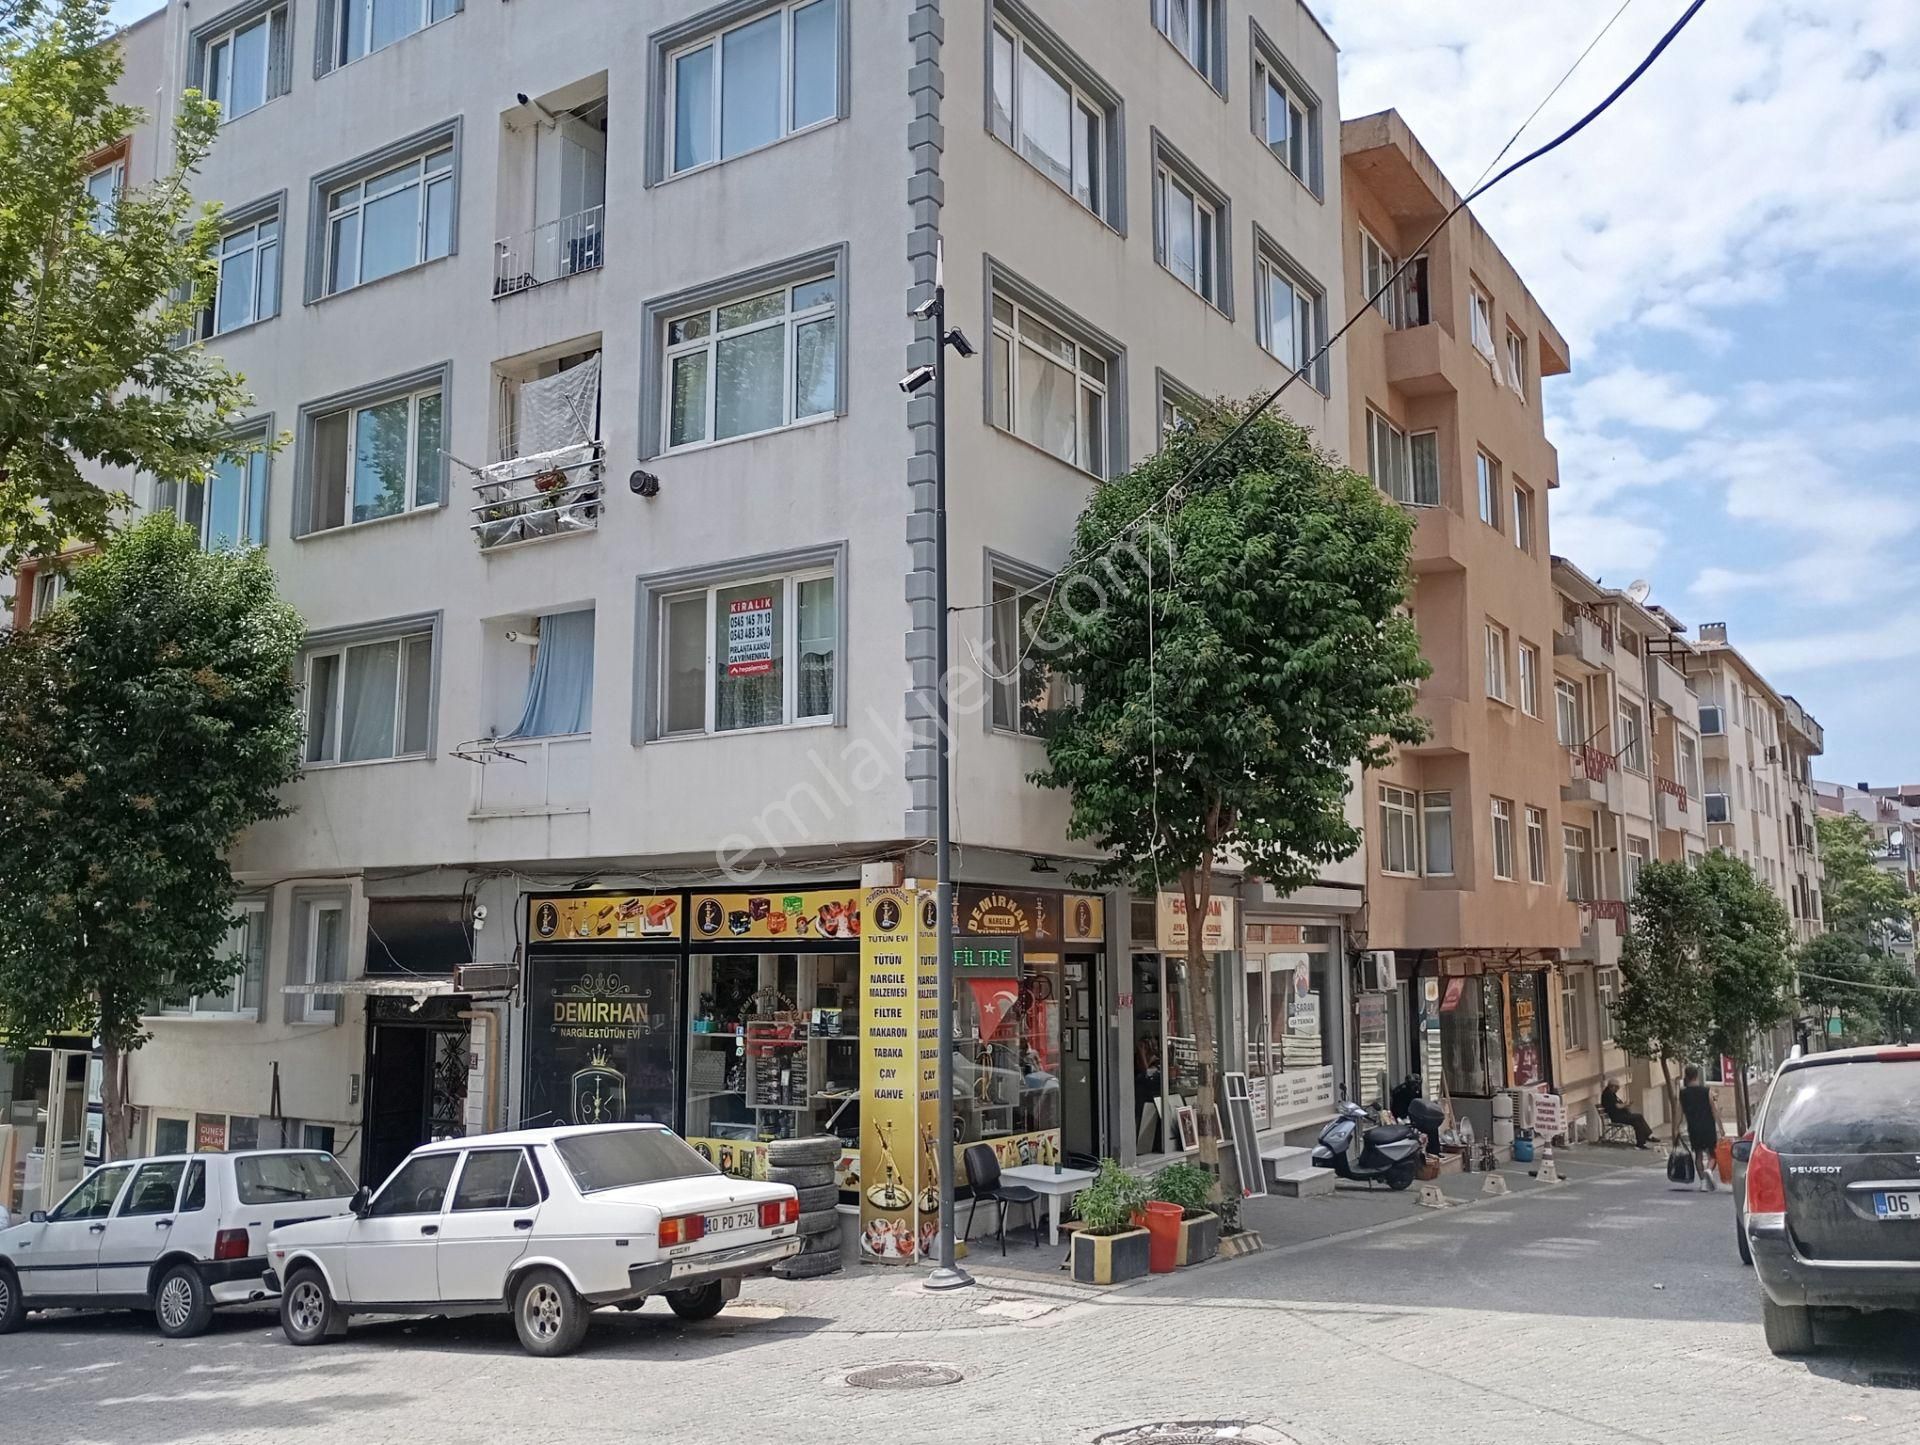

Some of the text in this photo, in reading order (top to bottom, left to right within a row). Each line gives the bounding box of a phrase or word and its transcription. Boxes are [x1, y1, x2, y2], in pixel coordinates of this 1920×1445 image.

[730, 612, 771, 628] 0545 145 71 13
[730, 625, 771, 641] 0543 485 34 16
[968, 892, 1029, 933] DEMİRHAN
[874, 953, 902, 965] TÜTÜN
[954, 946, 1012, 966] FİLTRE
[554, 997, 649, 1023] DEMİRHAN
[869, 1027, 908, 1038] MAKARON
[874, 1048, 904, 1058] TABAKA
[879, 1068, 897, 1081] ÇAY
[874, 1089, 904, 1100] KAHVE
[1789, 1165, 1843, 1175] PEUGEOT
[1888, 1195, 1909, 1212] 06
[707, 1212, 754, 1233] 10 PD 734
